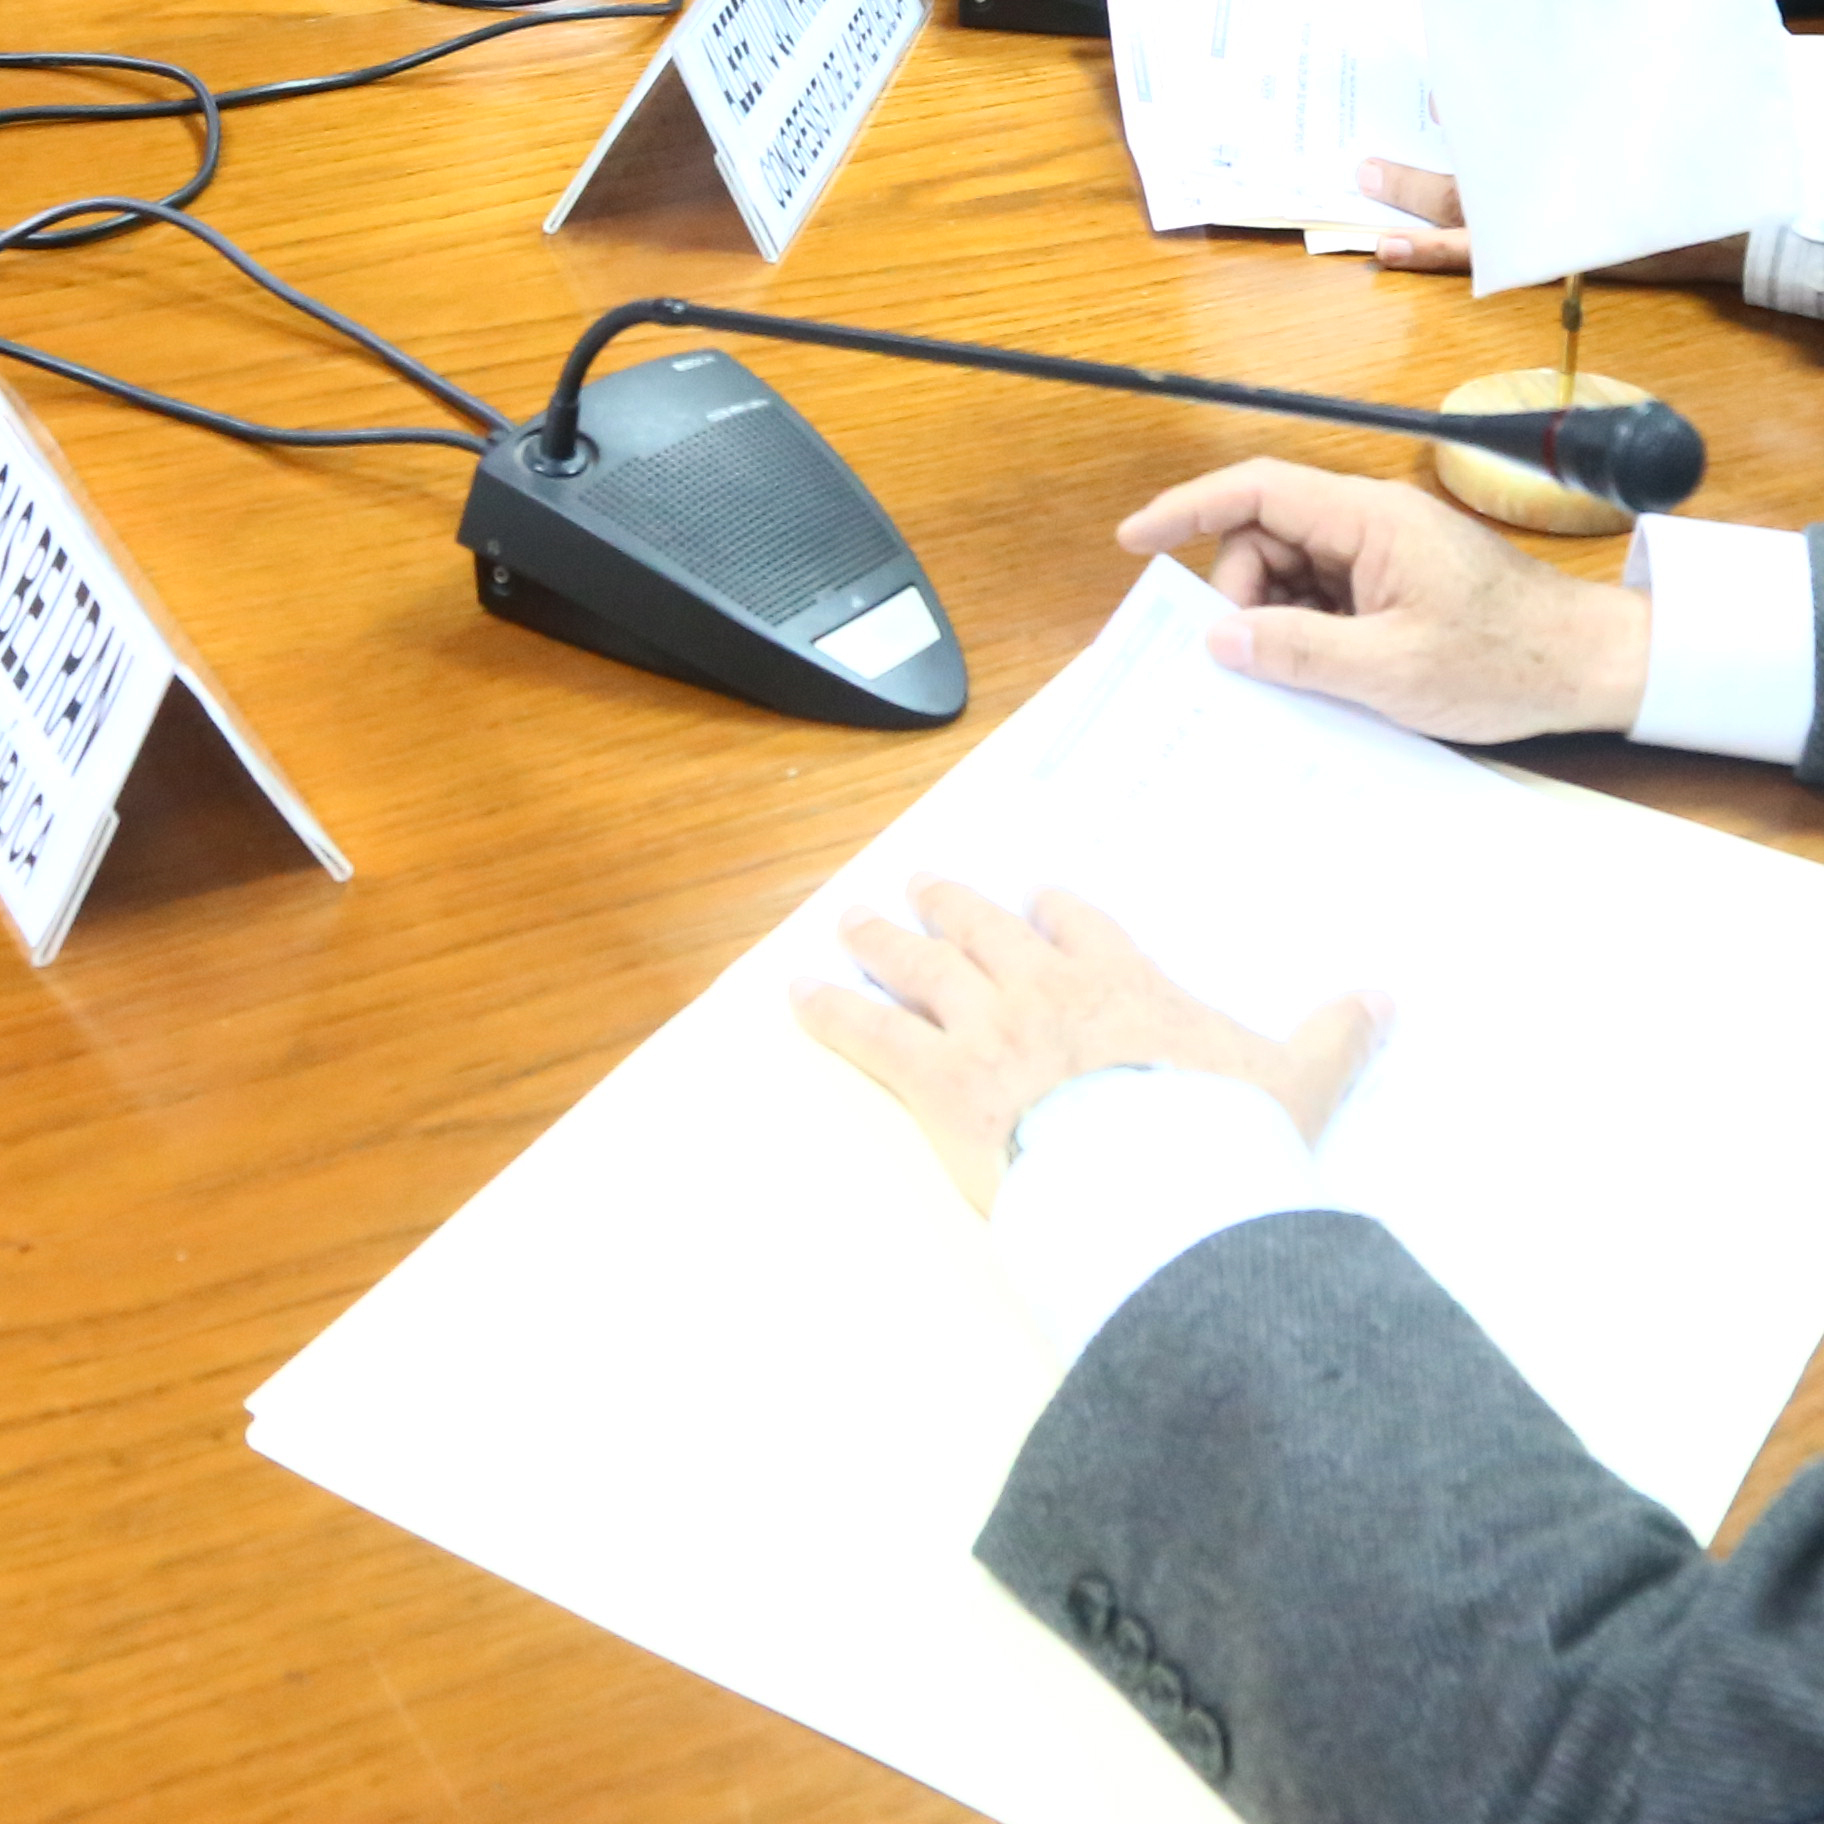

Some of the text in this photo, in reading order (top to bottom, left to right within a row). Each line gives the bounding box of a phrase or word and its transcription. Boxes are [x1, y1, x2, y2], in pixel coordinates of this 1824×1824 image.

[821, 49, 855, 112] DE
[834, 31, 866, 91] LA
[757, 70, 842, 213] CONGRESISTA
